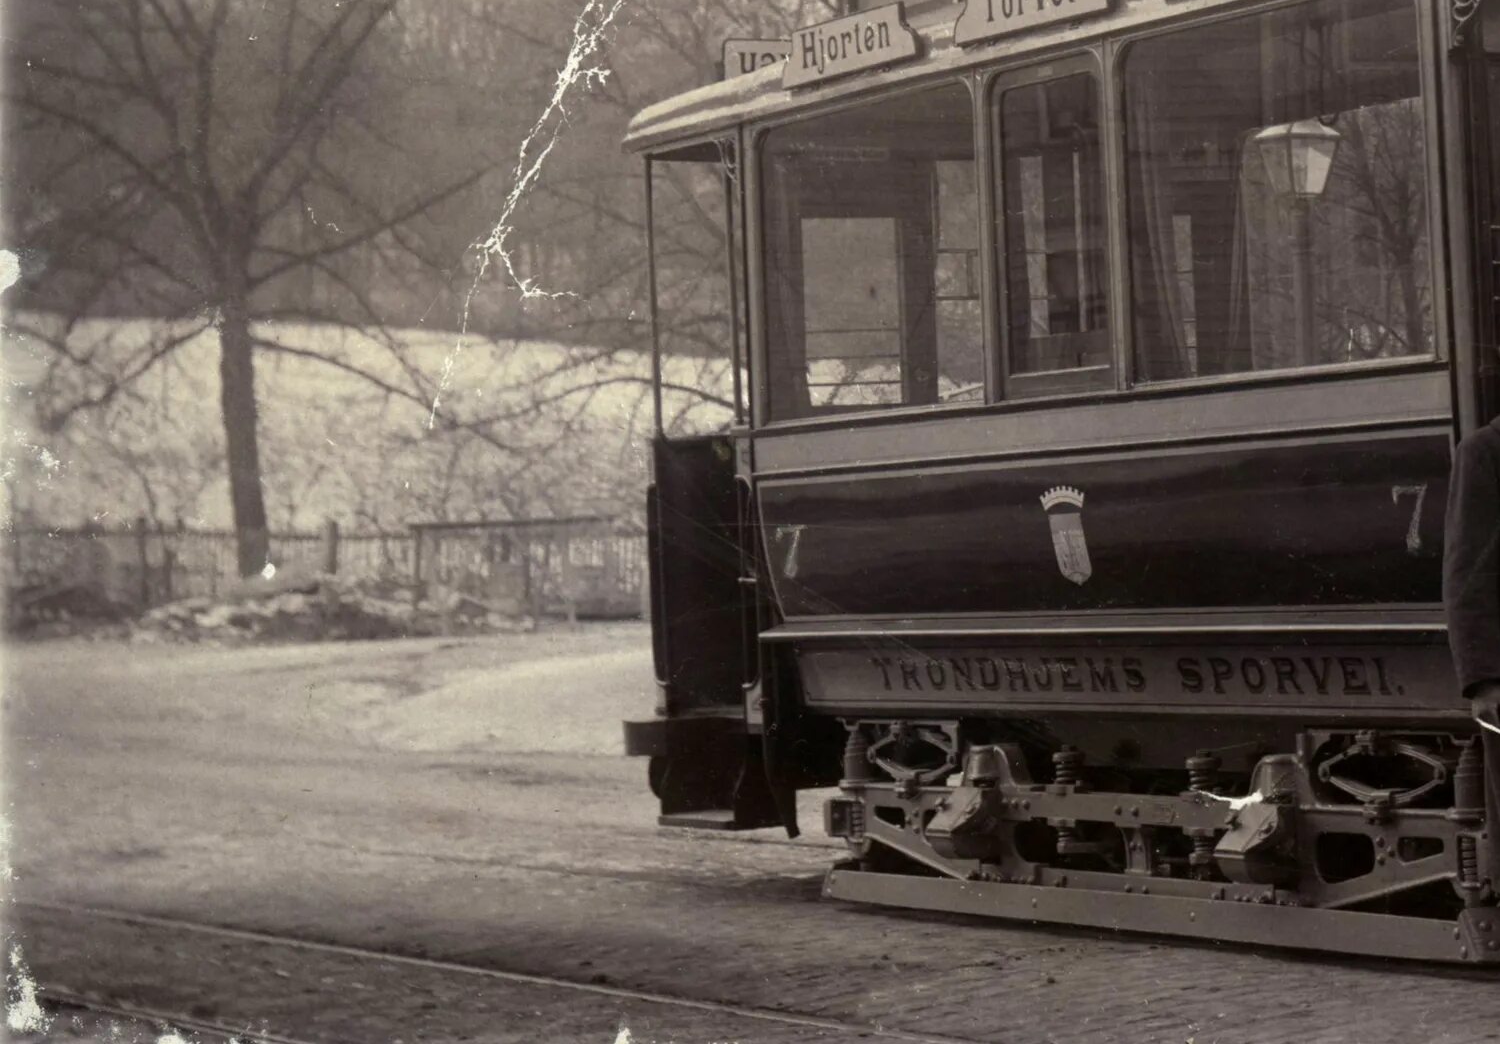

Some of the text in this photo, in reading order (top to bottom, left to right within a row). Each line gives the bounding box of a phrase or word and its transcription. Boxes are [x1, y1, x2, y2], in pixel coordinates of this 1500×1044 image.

[800, 20, 891, 75] Hjorten
[1391, 484, 1428, 553] 7
[775, 523, 809, 578] 7
[876, 656, 1405, 697] TRONDHJEMS SPORVEI.
